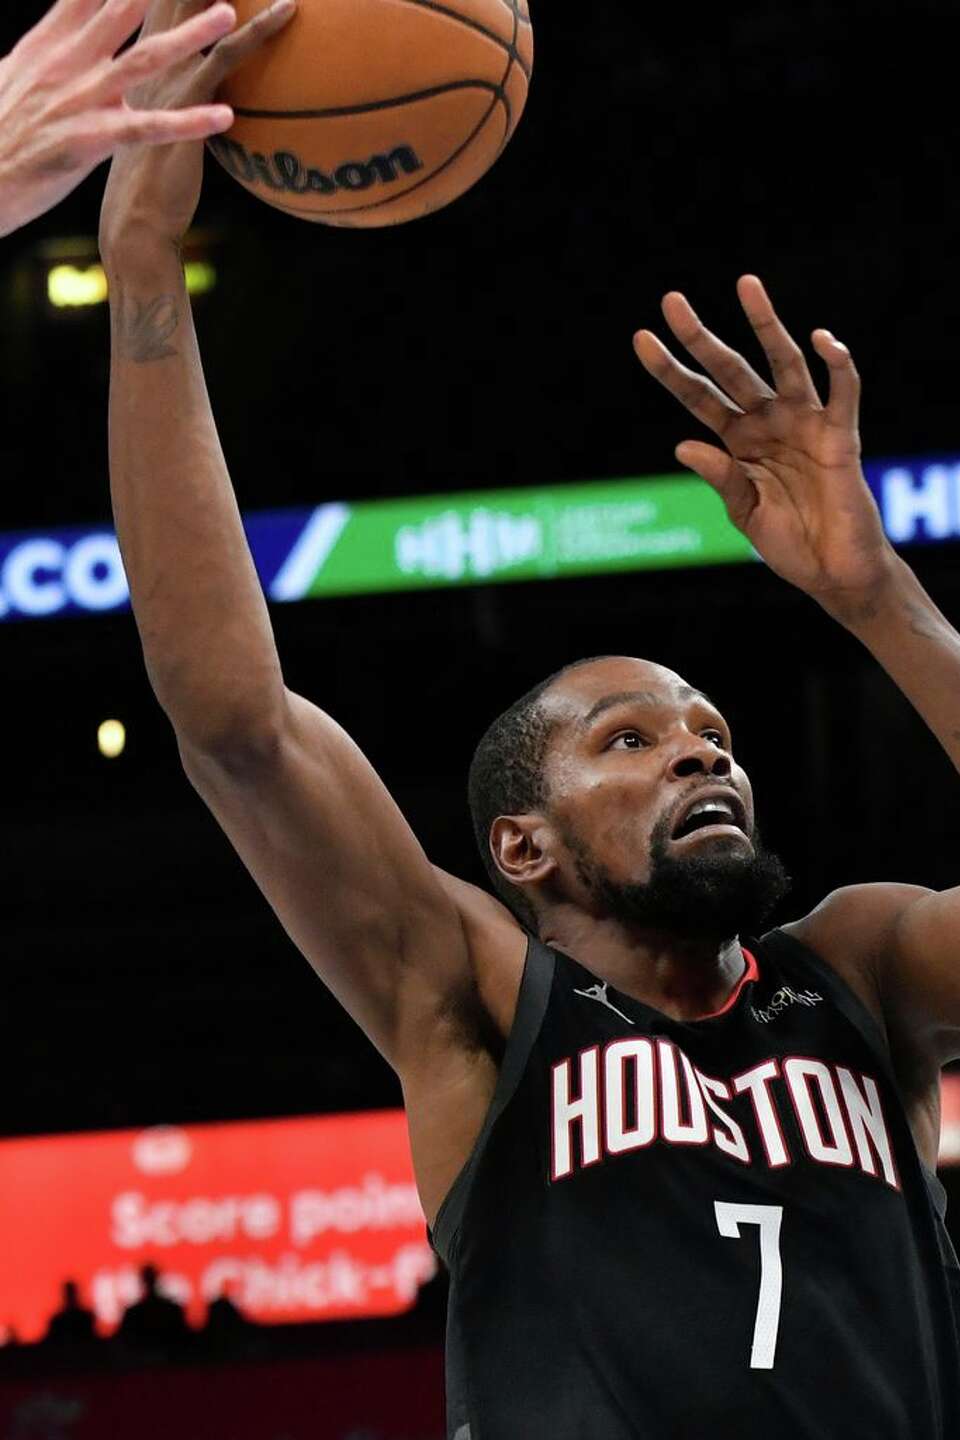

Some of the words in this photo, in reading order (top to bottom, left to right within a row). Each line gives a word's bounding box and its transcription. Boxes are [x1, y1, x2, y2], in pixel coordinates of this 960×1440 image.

[550, 1036, 900, 1191] HOUSTON
[110, 1191, 280, 1248] Score
[714, 1200, 783, 1369] 7
